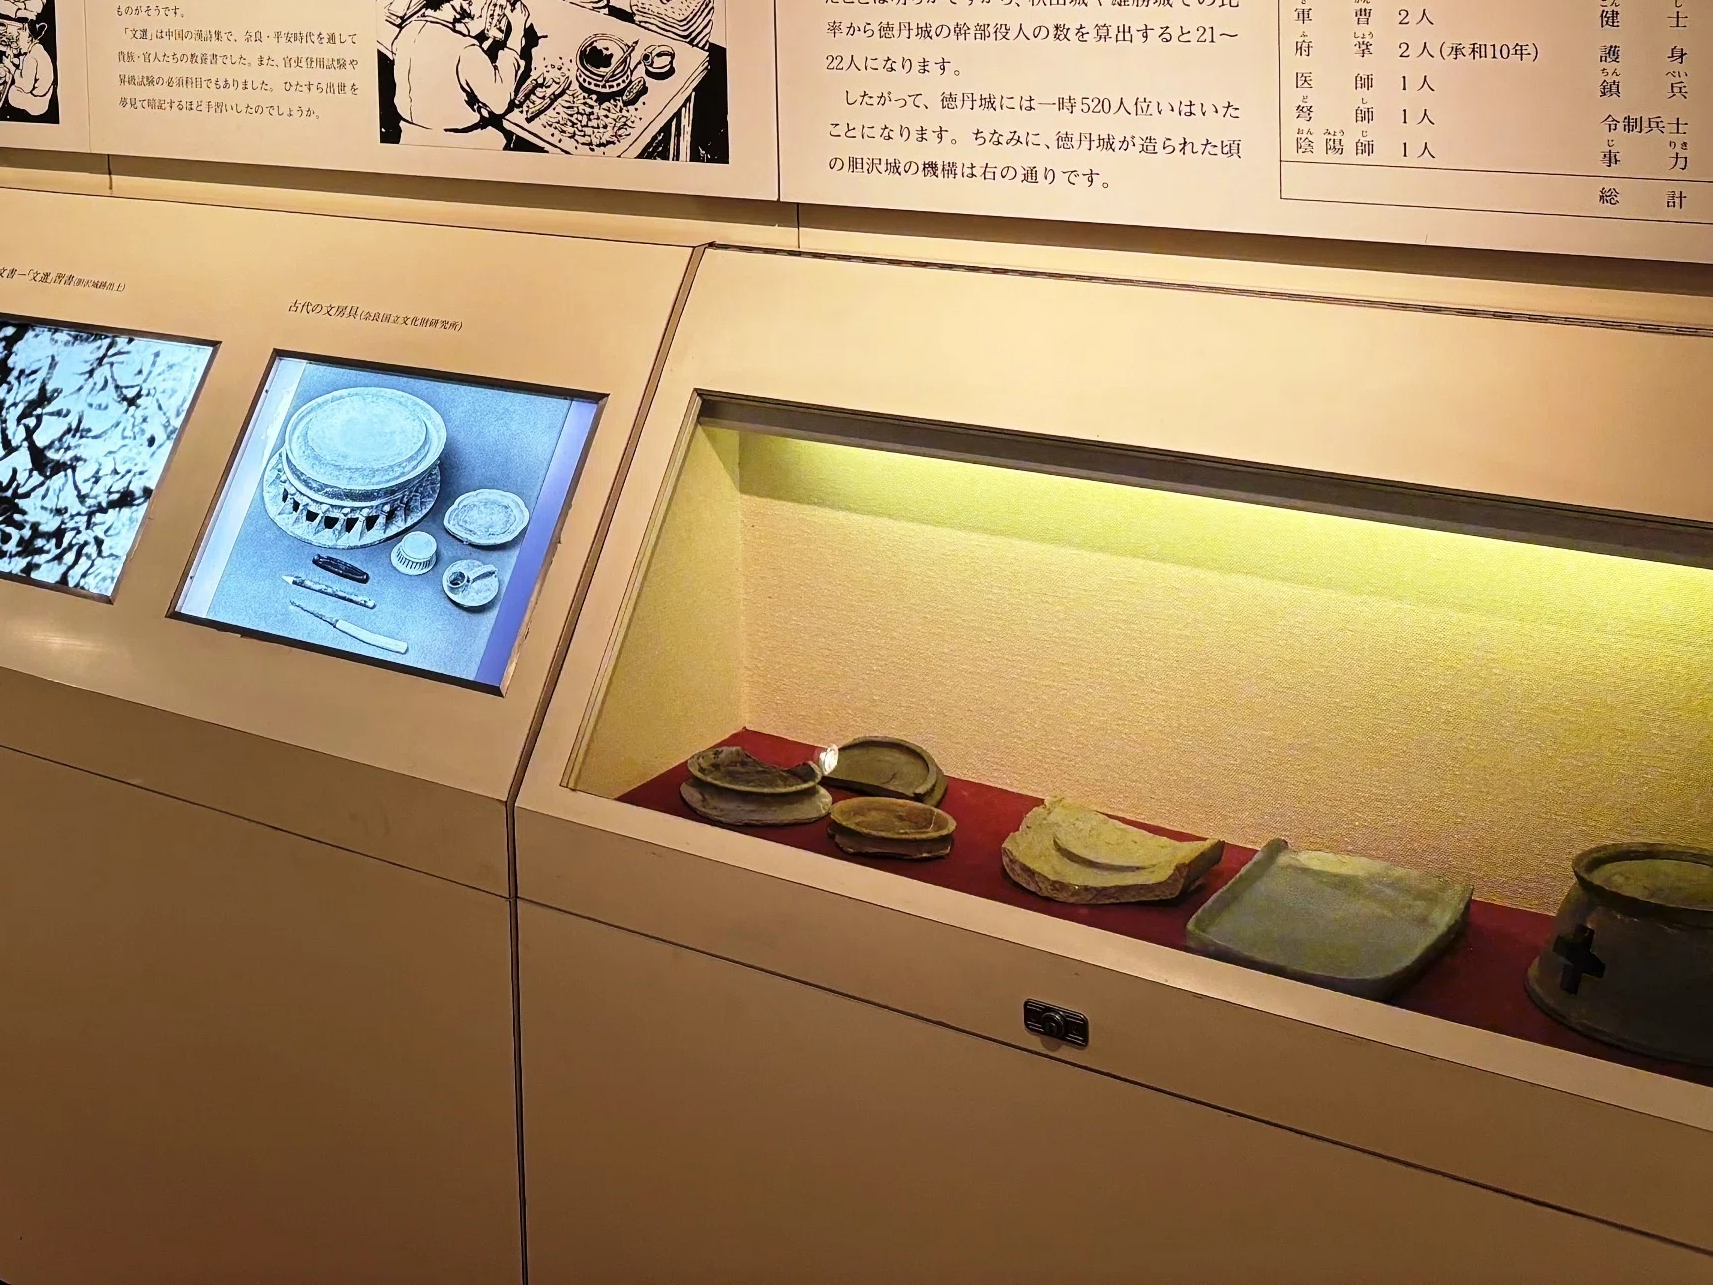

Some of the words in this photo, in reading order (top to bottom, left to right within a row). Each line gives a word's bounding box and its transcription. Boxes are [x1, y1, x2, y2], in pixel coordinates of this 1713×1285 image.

[116, 4, 185, 18] ものがそうです。
[826, 54, 961, 76] 22人になります。
[845, 90, 1241, 119] したがって、徳丹城には一時520人位いはいた
[1600, 115, 1688, 135] 令制兵士
[828, 156, 1110, 189] の胆沢城の機構は右の通りです。
